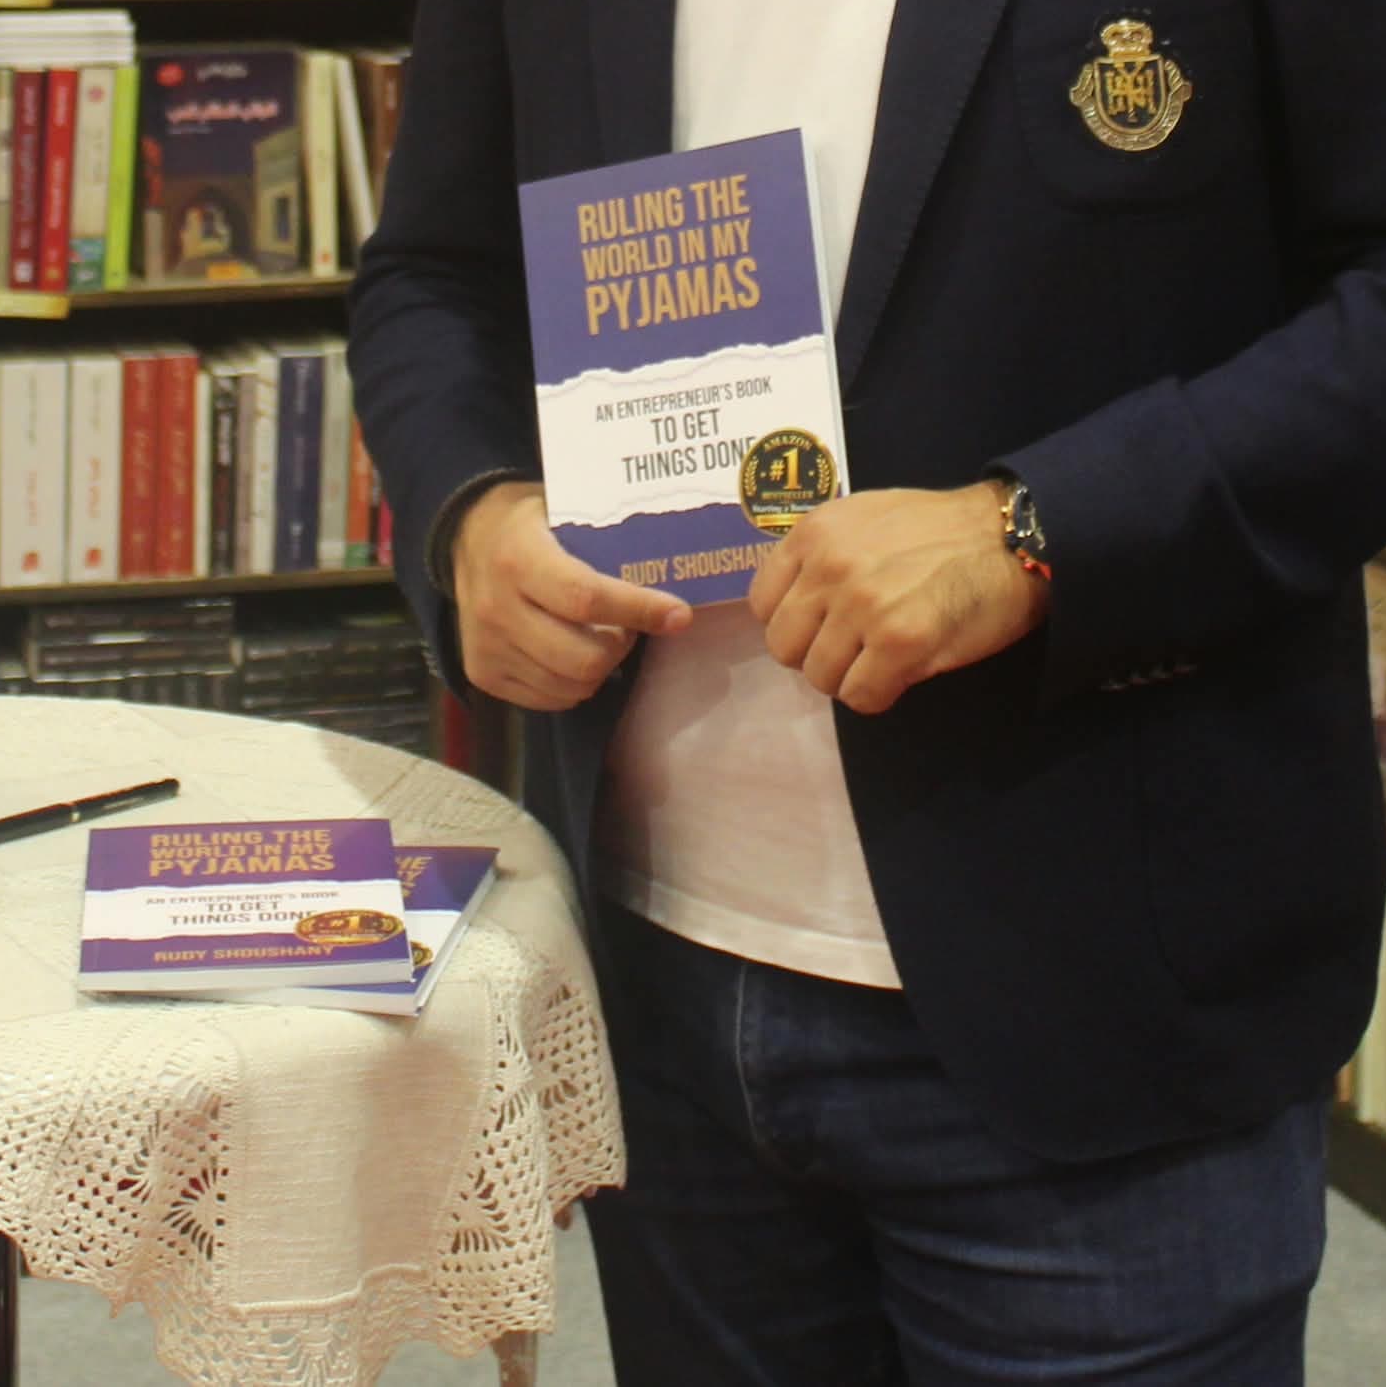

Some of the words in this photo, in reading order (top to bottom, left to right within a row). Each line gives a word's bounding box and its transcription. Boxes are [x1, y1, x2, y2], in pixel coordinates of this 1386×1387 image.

[577, 187, 684, 243] RULING
[691, 174, 750, 217] THE
[582, 232, 672, 281] WORLD
[679, 229, 705, 262] IN
[712, 219, 752, 255] MY
[586, 258, 759, 335] PYJAMAS
[595, 405, 614, 422] AN
[617, 385, 733, 420] ENTREPRENEUR'S
[737, 377, 772, 397] BOOK
[651, 417, 677, 445] TO
[683, 409, 720, 439] GET
[764, 434, 813, 452] AMAZON
[622, 447, 697, 484] THINGS
[769, 448, 801, 490] #1
[620, 560, 668, 587] RUDY
[150, 831, 263, 848] RULING
[277, 829, 331, 844] THE
[151, 843, 247, 860] WORLD
[255, 843, 282, 857] IN
[291, 842, 331, 857] MY
[149, 854, 334, 877] PYJAMAS
[301, 890, 339, 899] BOOK
[206, 902, 234, 913] TO
[241, 901, 279, 911] GET
[169, 912, 251, 926] THINGS
[331, 916, 361, 930] #1
[154, 949, 206, 962] RUDY
[214, 944, 334, 959] SHOUSHANY
